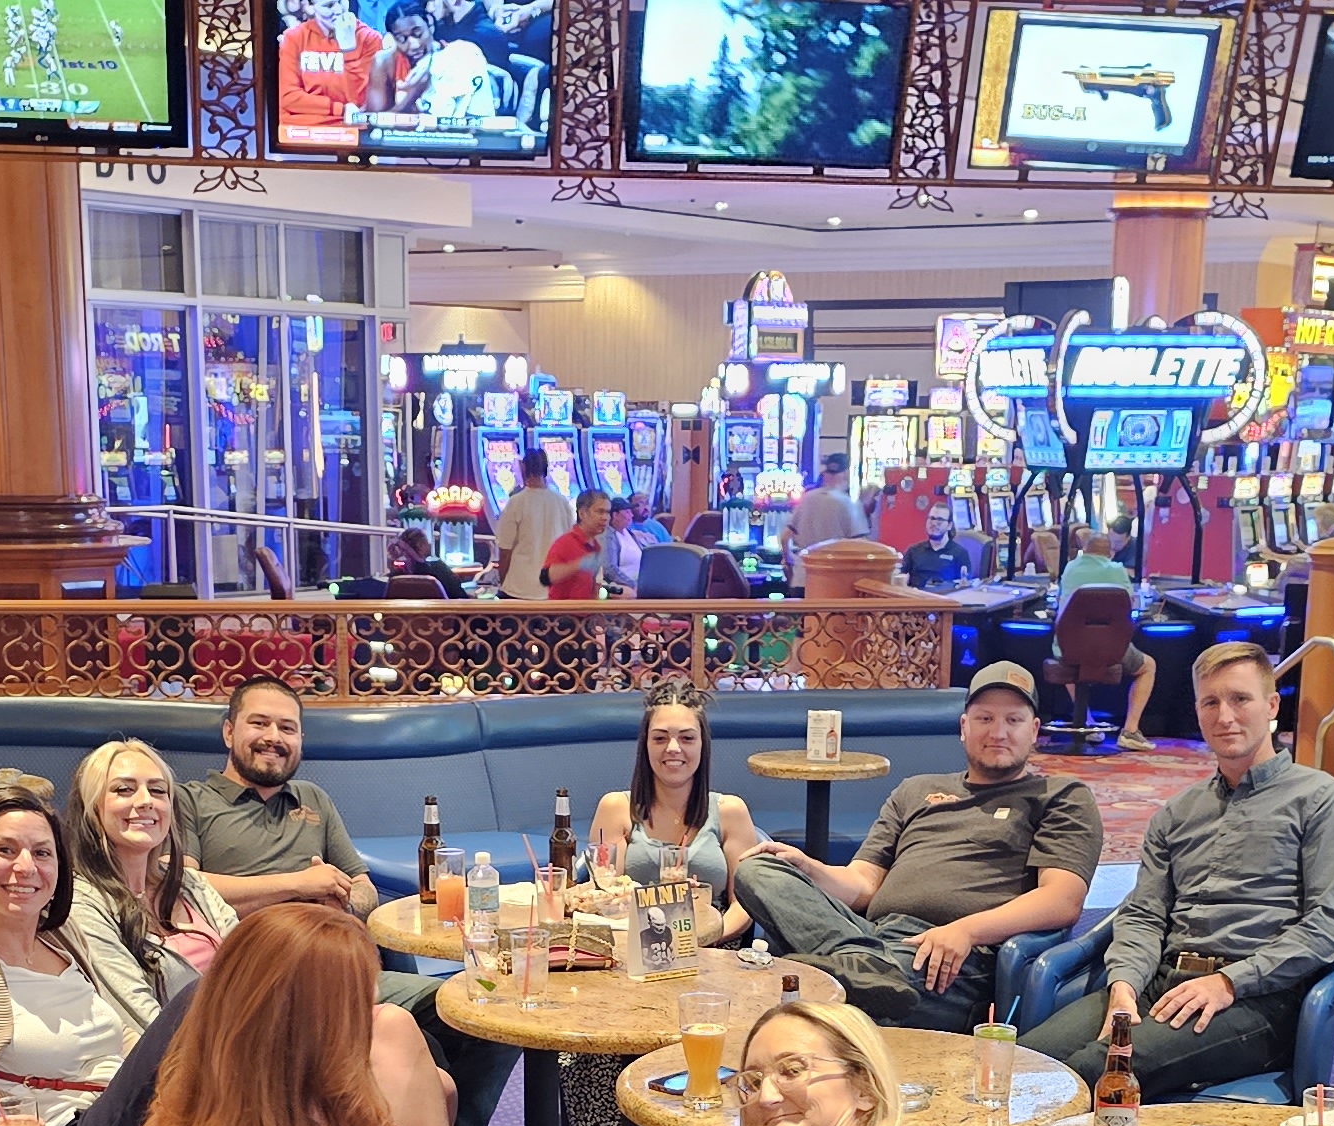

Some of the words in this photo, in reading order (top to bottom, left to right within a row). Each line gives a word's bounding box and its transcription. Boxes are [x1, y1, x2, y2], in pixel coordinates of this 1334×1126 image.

[98, 60, 119, 70] 10
[1070, 347, 1245, 387] ROULETTE
[637, 883, 689, 908] MNF
[672, 918, 692, 932] $15
